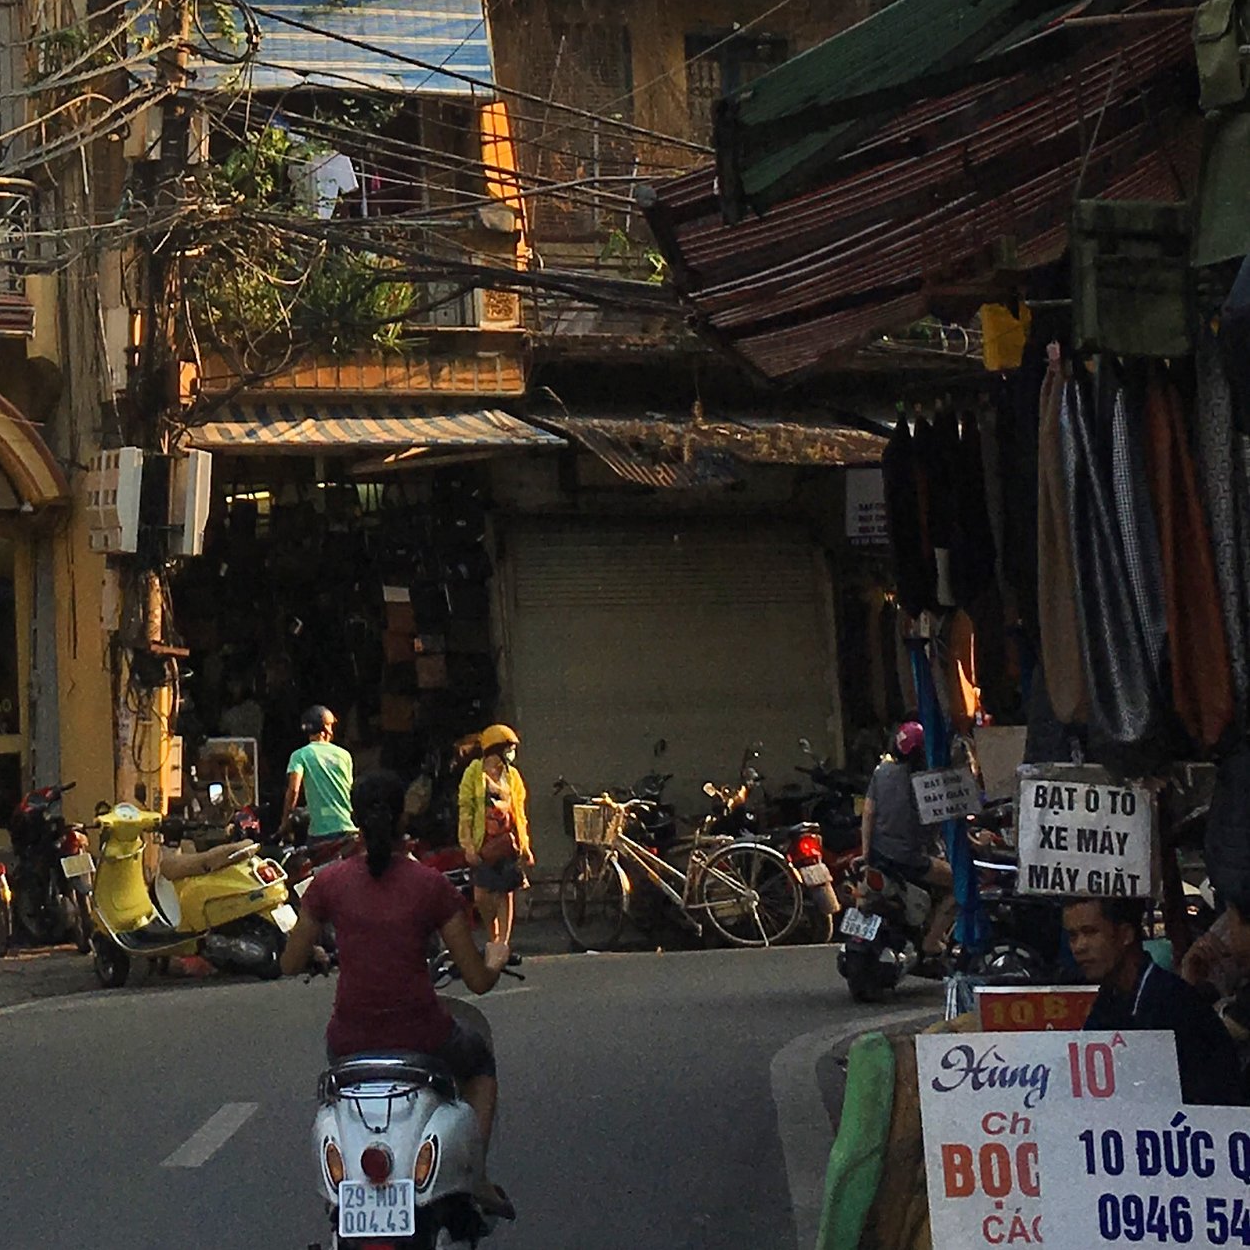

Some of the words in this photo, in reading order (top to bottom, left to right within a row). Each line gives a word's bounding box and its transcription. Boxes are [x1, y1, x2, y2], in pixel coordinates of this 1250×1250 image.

[1034, 784, 1078, 815] BẠT
[1085, 783, 1100, 813] Ô
[1108, 784, 1136, 816] TÔ
[1039, 824, 1069, 851] XE
[1076, 825, 1129, 856] MÁY
[1028, 862, 1080, 892] MÁY
[931, 1043, 1051, 1108] Hùng
[1078, 1129, 1125, 1177] 10
[1136, 1111, 1215, 1178] ĐỨC
[344, 1209, 410, 1234] 004.43
[1098, 1192, 1194, 1244] 0946
